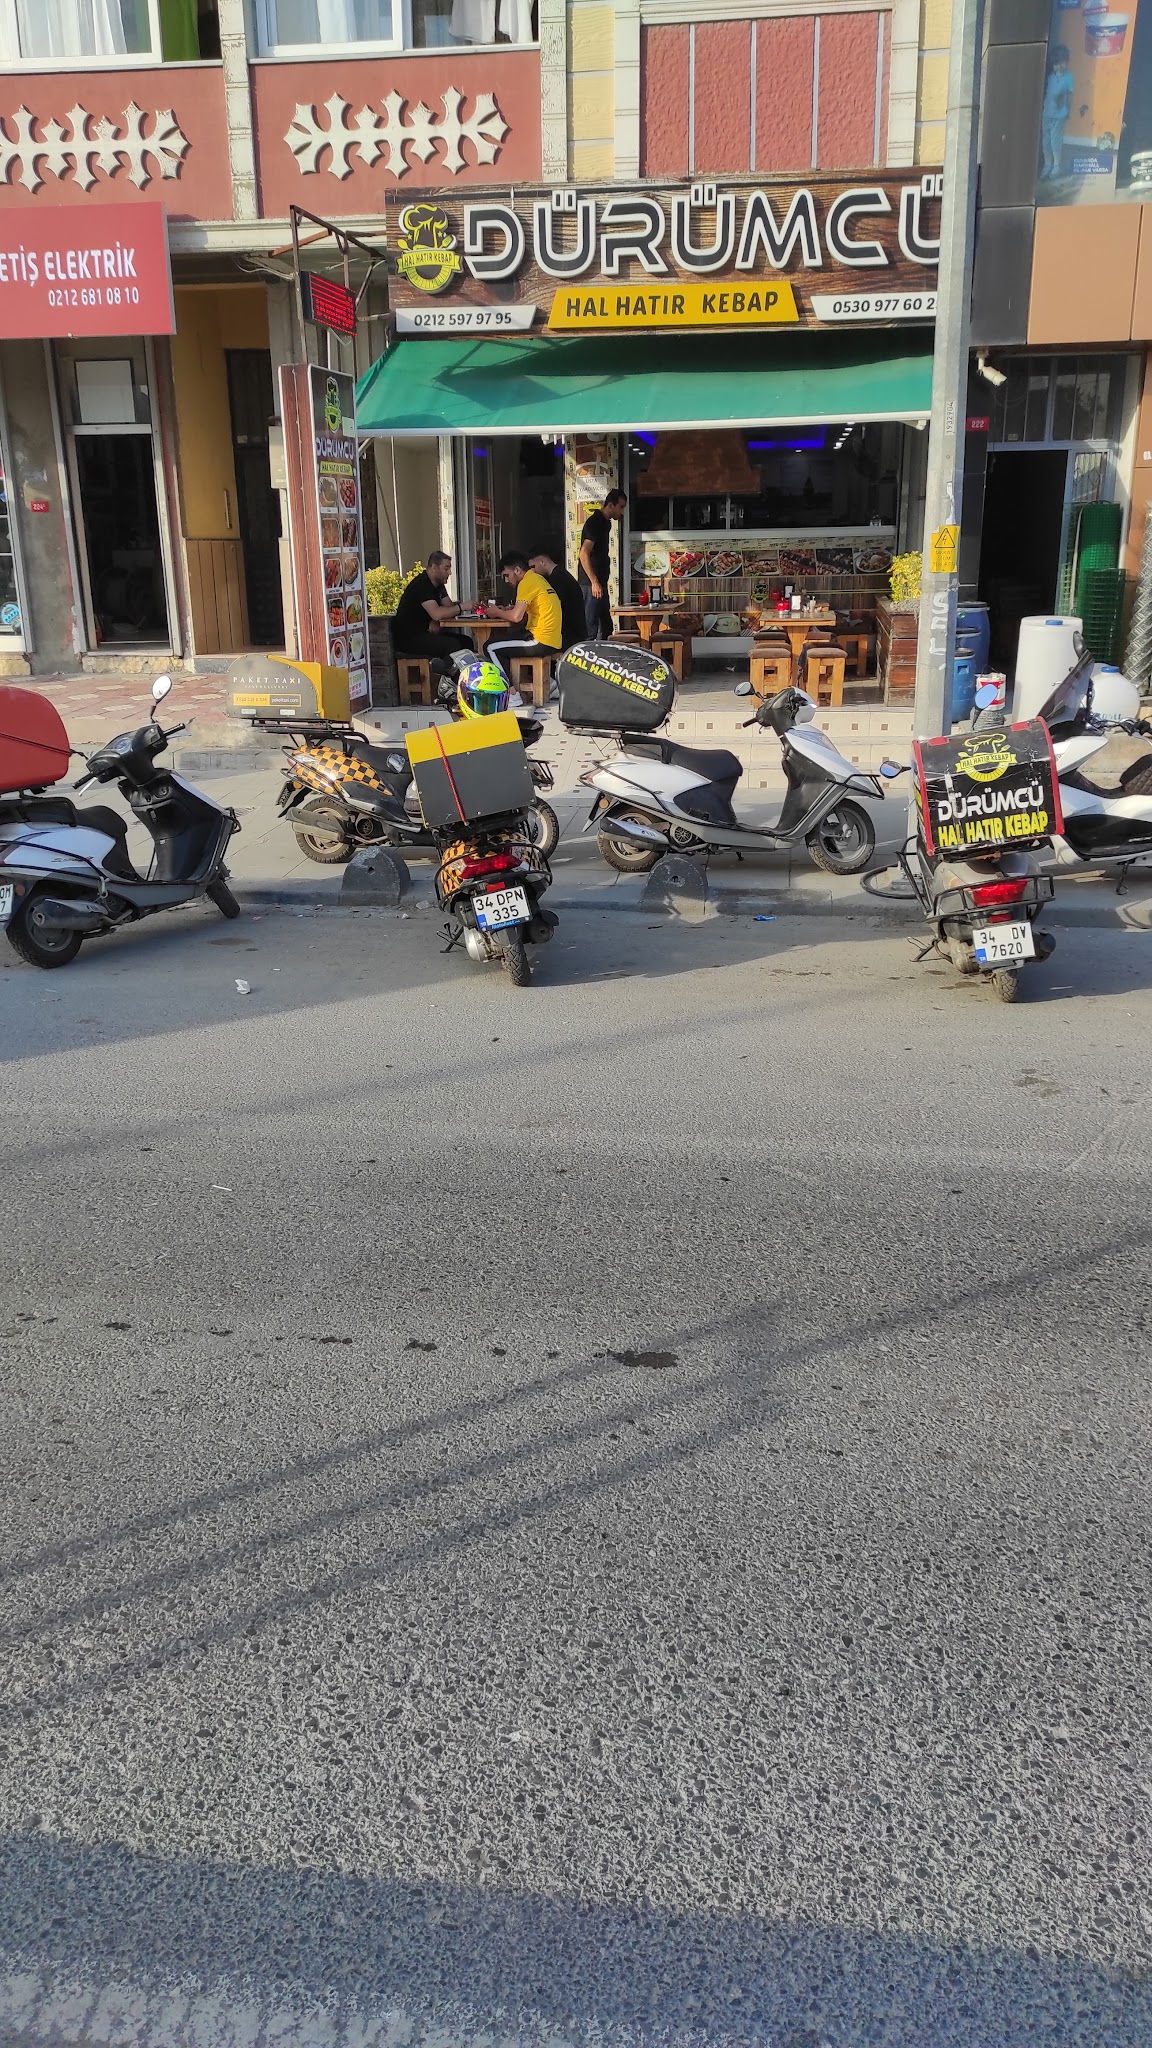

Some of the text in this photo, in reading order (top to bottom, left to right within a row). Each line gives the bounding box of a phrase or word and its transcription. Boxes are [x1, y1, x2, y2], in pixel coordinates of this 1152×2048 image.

[464, 174, 943, 281] DÜRÜMCÜ
[44, 241, 137, 281] ELEKTRİK
[403, 252, 453, 265] HAL HATIR KEBAP
[48, 286, 139, 306] 0212 681 08 10
[566, 290, 779, 317] HAL HATIR KEBAP
[833, 300, 871, 314] 0530
[874, 299, 900, 312] 977
[903, 298, 922, 311] 60
[414, 312, 512, 326] 0212 597 97 95
[971, 420, 985, 429] 222
[566, 653, 659, 700] HAL HATIR KEBAP
[572, 643, 662, 691] DÜRÜMCÜ
[233, 676, 269, 684] PAKET
[962, 753, 1010, 768] HAL HATIR KEBAP
[937, 780, 1045, 822] DÜRÜMCÜ
[937, 810, 1049, 847] HAL HATIR KEBAP
[475, 889, 524, 911] 34 DPN
[492, 905, 519, 921] 335
[980, 925, 1026, 944] 34 DV
[991, 942, 1023, 958] 7620
